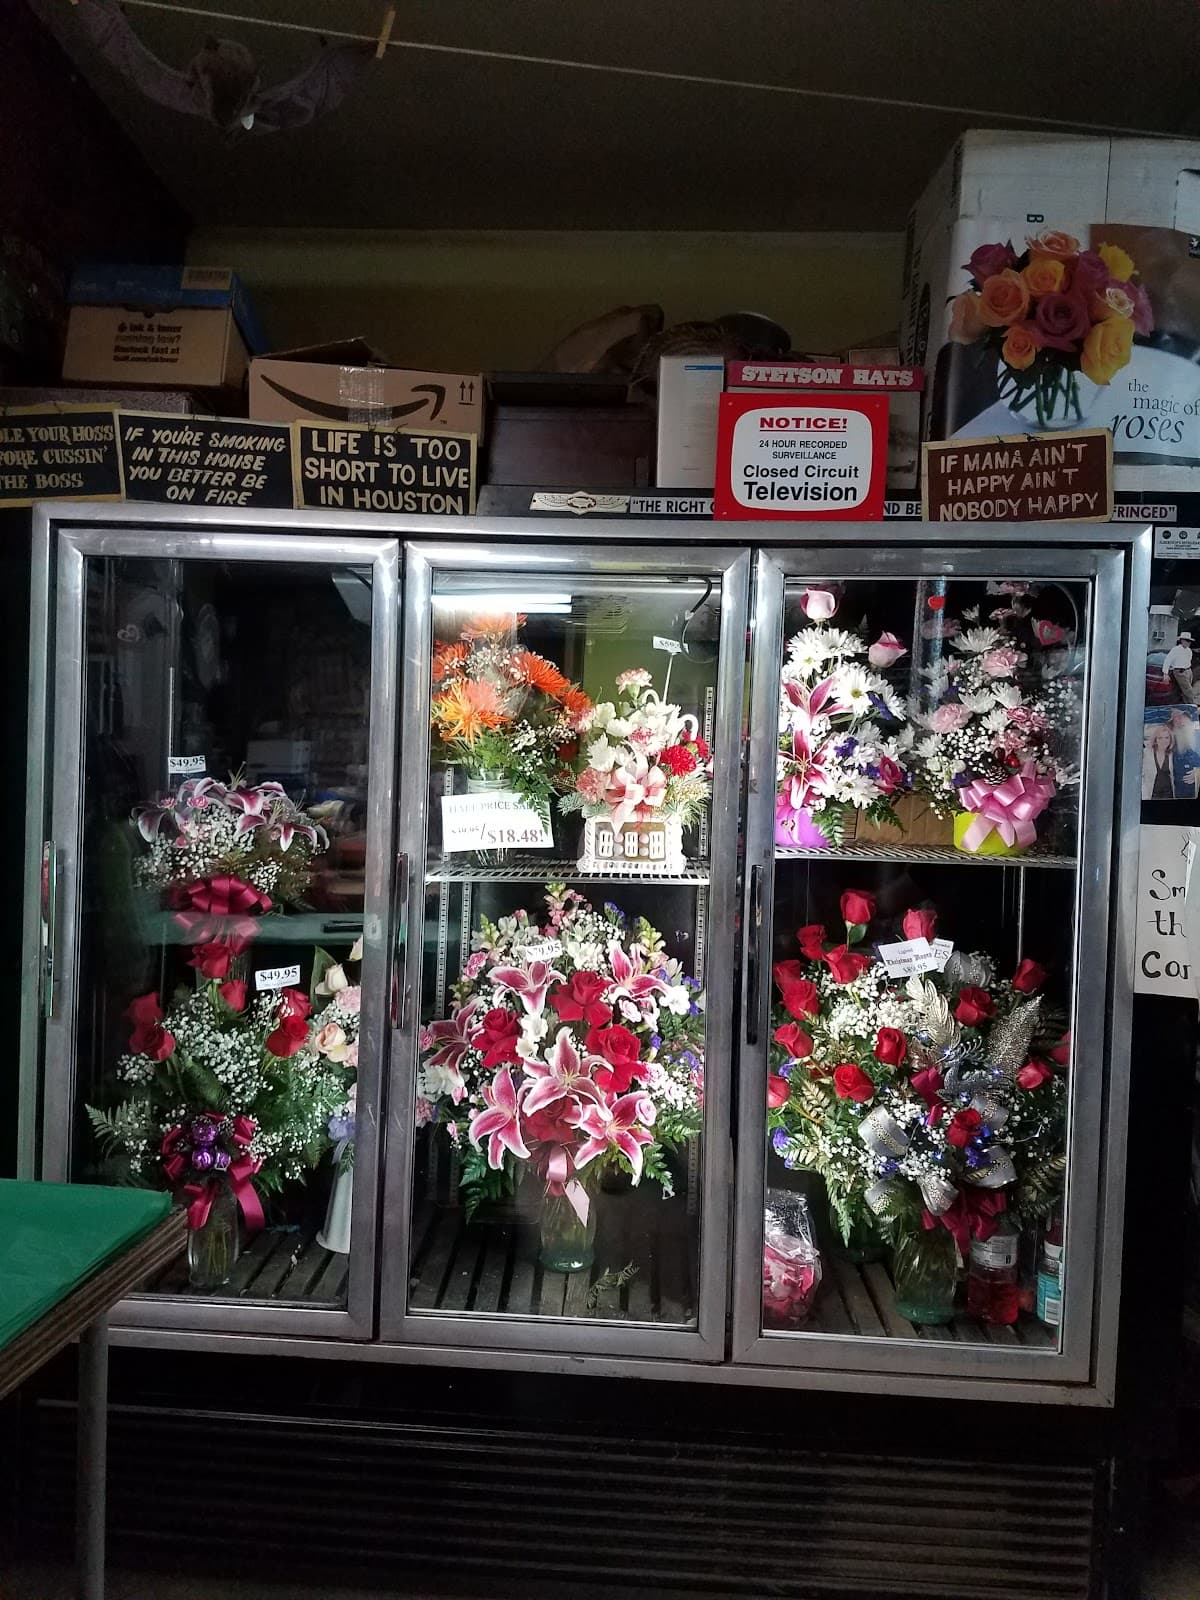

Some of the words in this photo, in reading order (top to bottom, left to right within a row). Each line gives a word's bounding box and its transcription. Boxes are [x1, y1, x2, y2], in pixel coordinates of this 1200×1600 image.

[742, 365, 843, 384] STETSON
[853, 369, 914, 386] HATS
[1128, 378, 1149, 392] the
[1133, 394, 1180, 416] magic
[1183, 399, 1200, 416] of
[760, 417, 848, 429] NOTICE!
[1112, 414, 1185, 443] roses
[26, 425, 72, 446] YOUR
[71, 424, 115, 442] HOSS
[125, 426, 144, 441] IF
[151, 425, 204, 447] YOU'RE
[208, 432, 287, 453] SMOKING
[311, 430, 361, 455] LIFE
[374, 434, 398, 458] IS
[409, 437, 461, 460] TOO
[759, 440, 769, 448] 24
[771, 440, 796, 448] HOUR
[799, 441, 848, 449] RECORDED
[131, 446, 154, 462] IN
[158, 447, 201, 466] THIS
[203, 452, 267, 471] HOUSE
[772, 451, 837, 460] SURVEILLANCE
[940, 455, 958, 474] IF
[963, 450, 1023, 472] MAMA
[1028, 443, 1088, 467] AIN'T
[34, 472, 84, 489] BOSS
[128, 465, 162, 481] YOU
[167, 468, 237, 487] BETTER
[240, 473, 269, 489] BE
[304, 457, 380, 483] SHORT
[387, 463, 416, 486] TO
[422, 464, 470, 489] LIVE
[743, 465, 799, 479] Closed
[804, 466, 859, 479] Circuit
[166, 485, 196, 502] ON
[203, 489, 254, 506] FIRE
[743, 482, 858, 501] Television
[947, 474, 1015, 496] HAPPY
[320, 486, 344, 506] IN
[352, 487, 464, 515] HOUSTON
[632, 501, 661, 513] "THE
[666, 501, 706, 513] RIGHT
[940, 499, 1021, 521] NOBODY
[1028, 492, 1099, 515] HAPPY
[260, 968, 297, 982] $49.95
